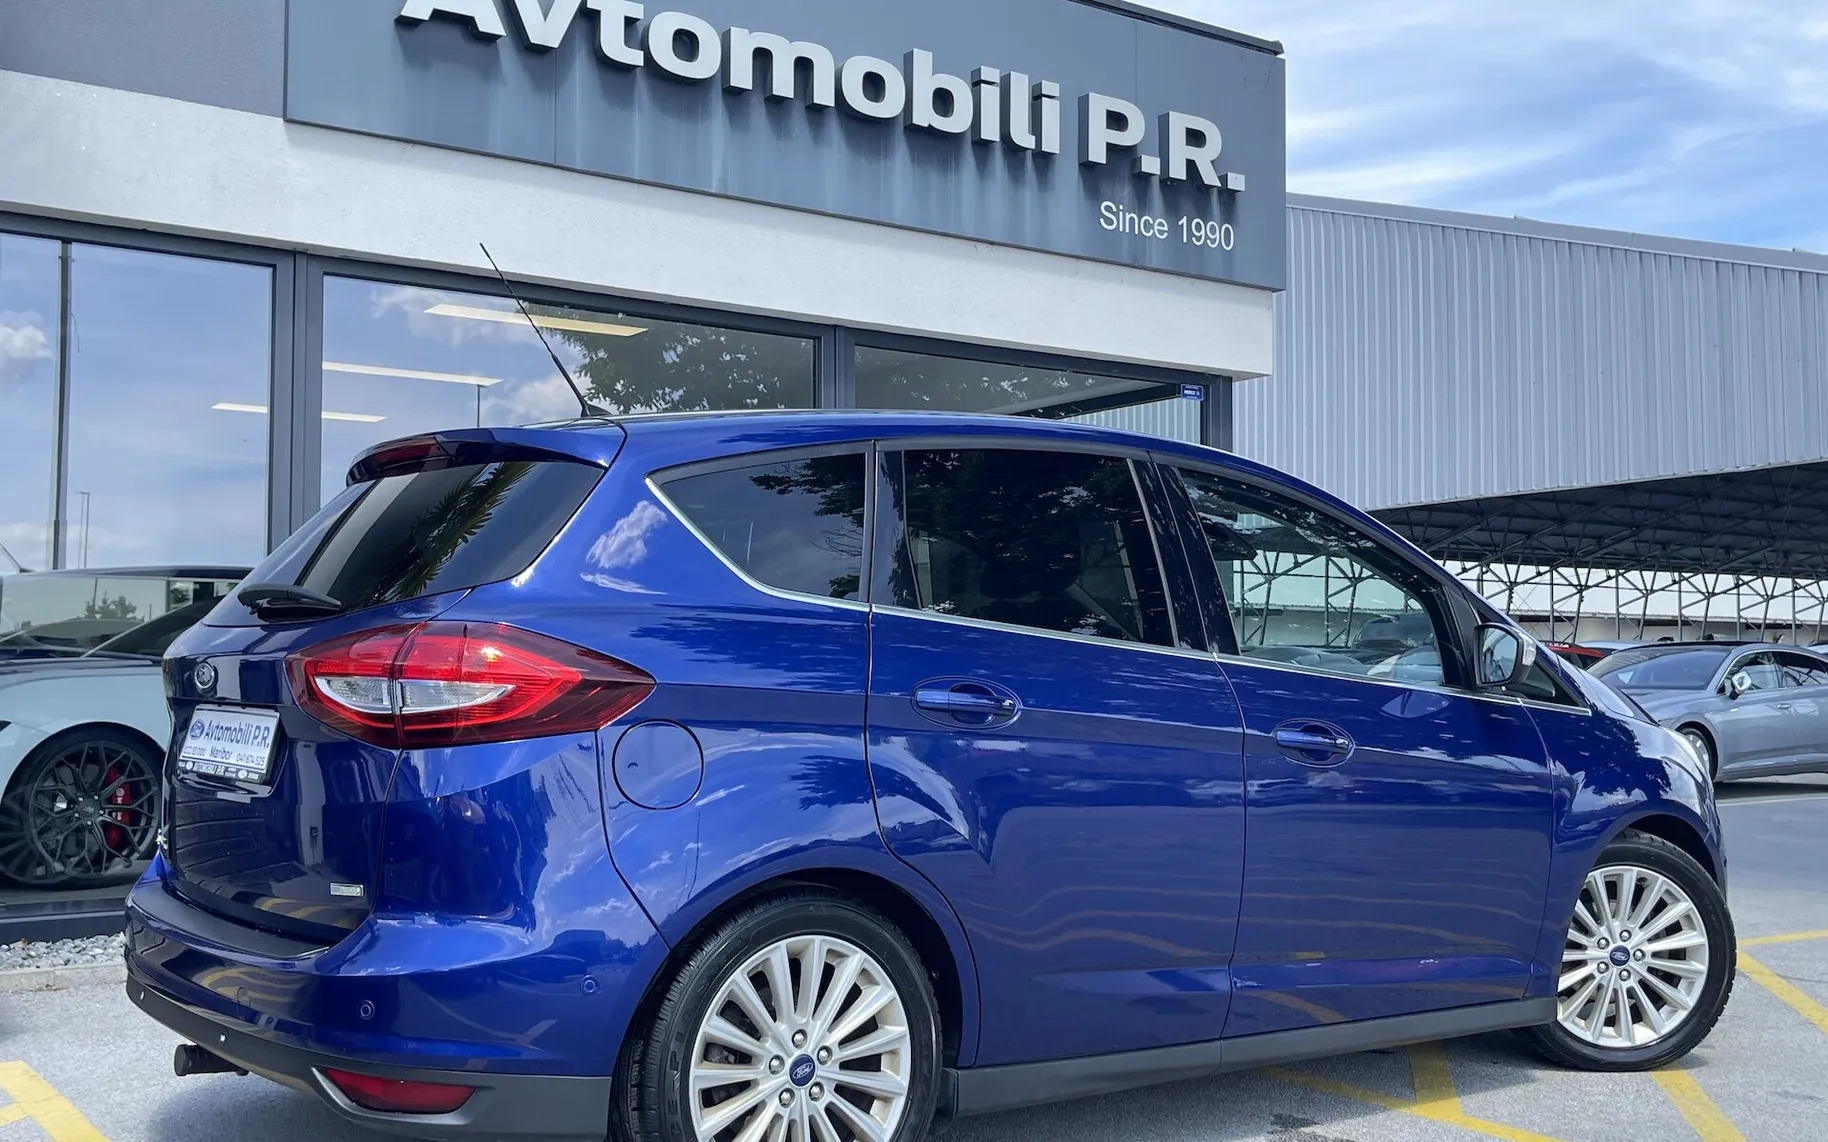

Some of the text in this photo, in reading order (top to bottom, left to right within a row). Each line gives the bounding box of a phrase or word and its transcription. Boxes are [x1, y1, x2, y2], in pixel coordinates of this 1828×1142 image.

[1080, 92, 1246, 192] P.R.
[1100, 201, 1235, 251] Since 1990
[204, 720, 254, 746] Avtomobili
[251, 725, 270, 748] P.R.
[210, 746, 233, 760] Maribor
